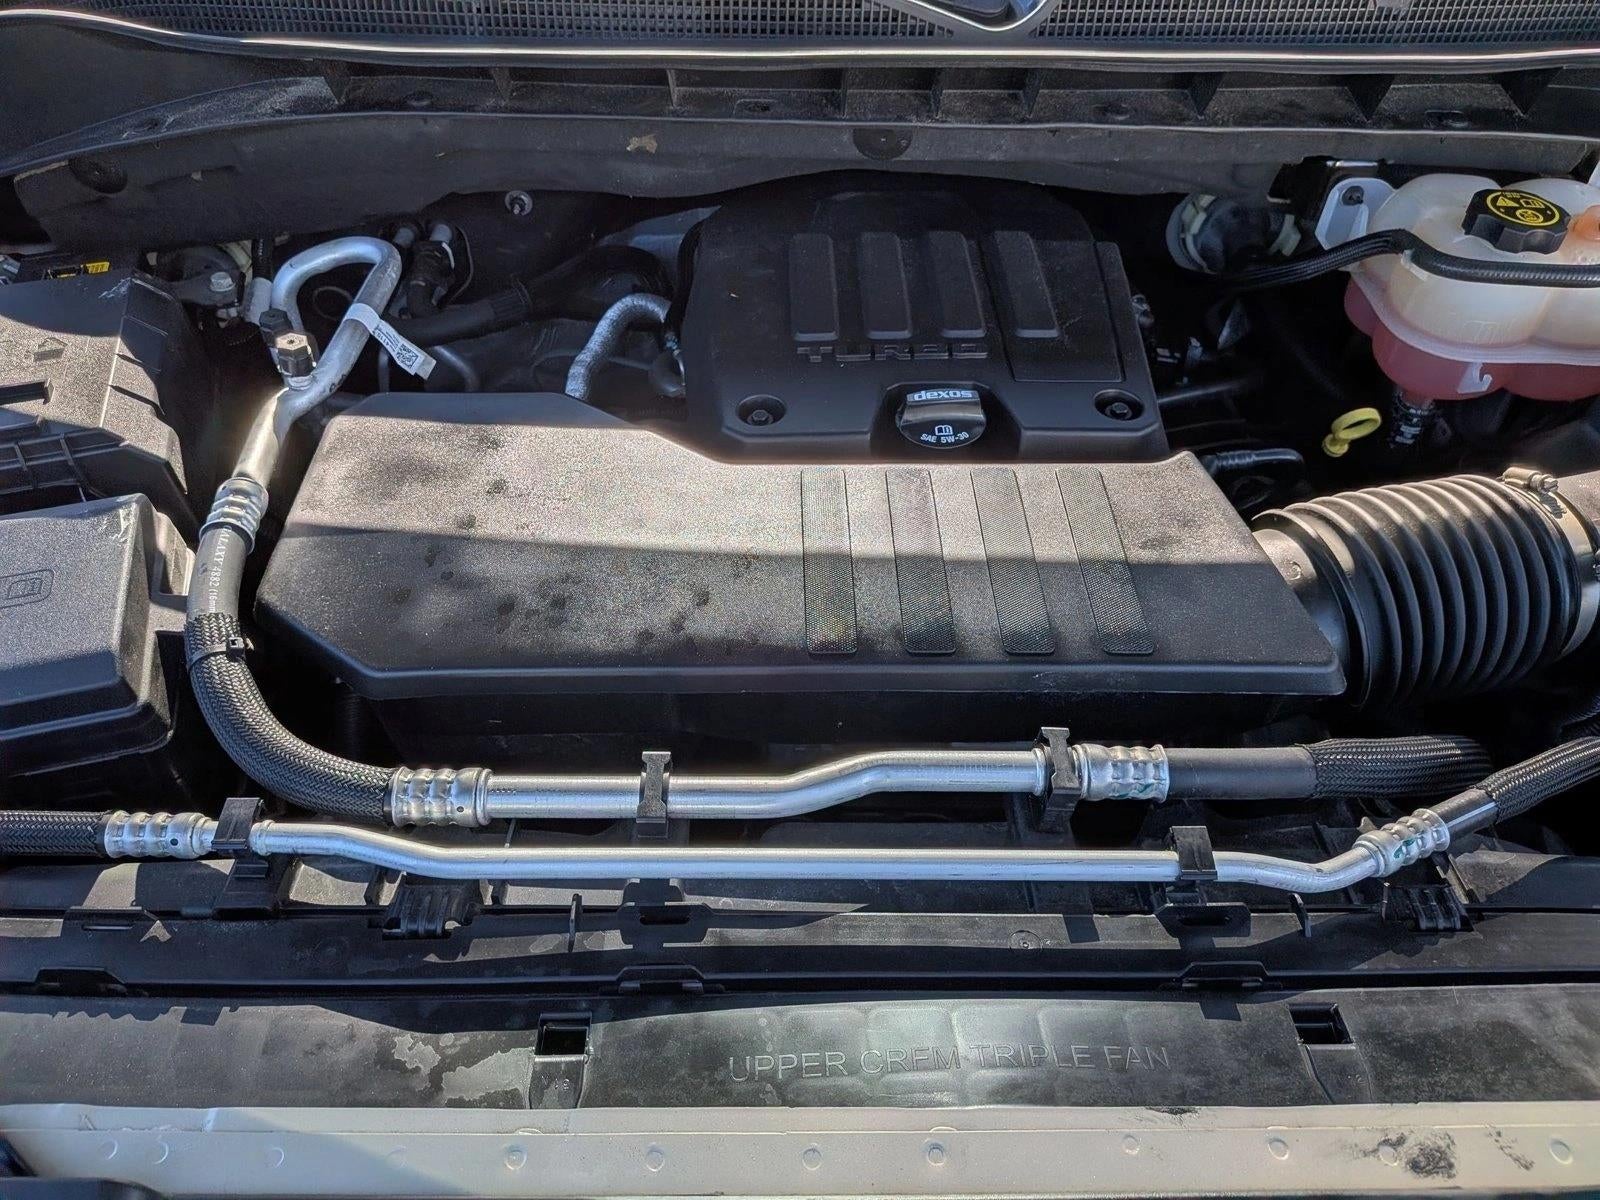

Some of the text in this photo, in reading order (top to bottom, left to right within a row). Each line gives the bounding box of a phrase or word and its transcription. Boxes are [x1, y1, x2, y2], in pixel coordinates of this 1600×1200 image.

[914, 390, 973, 401] dexos
[920, 431, 969, 444] SAE 5W-30
[209, 566, 222, 587] 4882
[729, 1044, 1169, 1082] UPPER CRFM TRIPLE FAN
